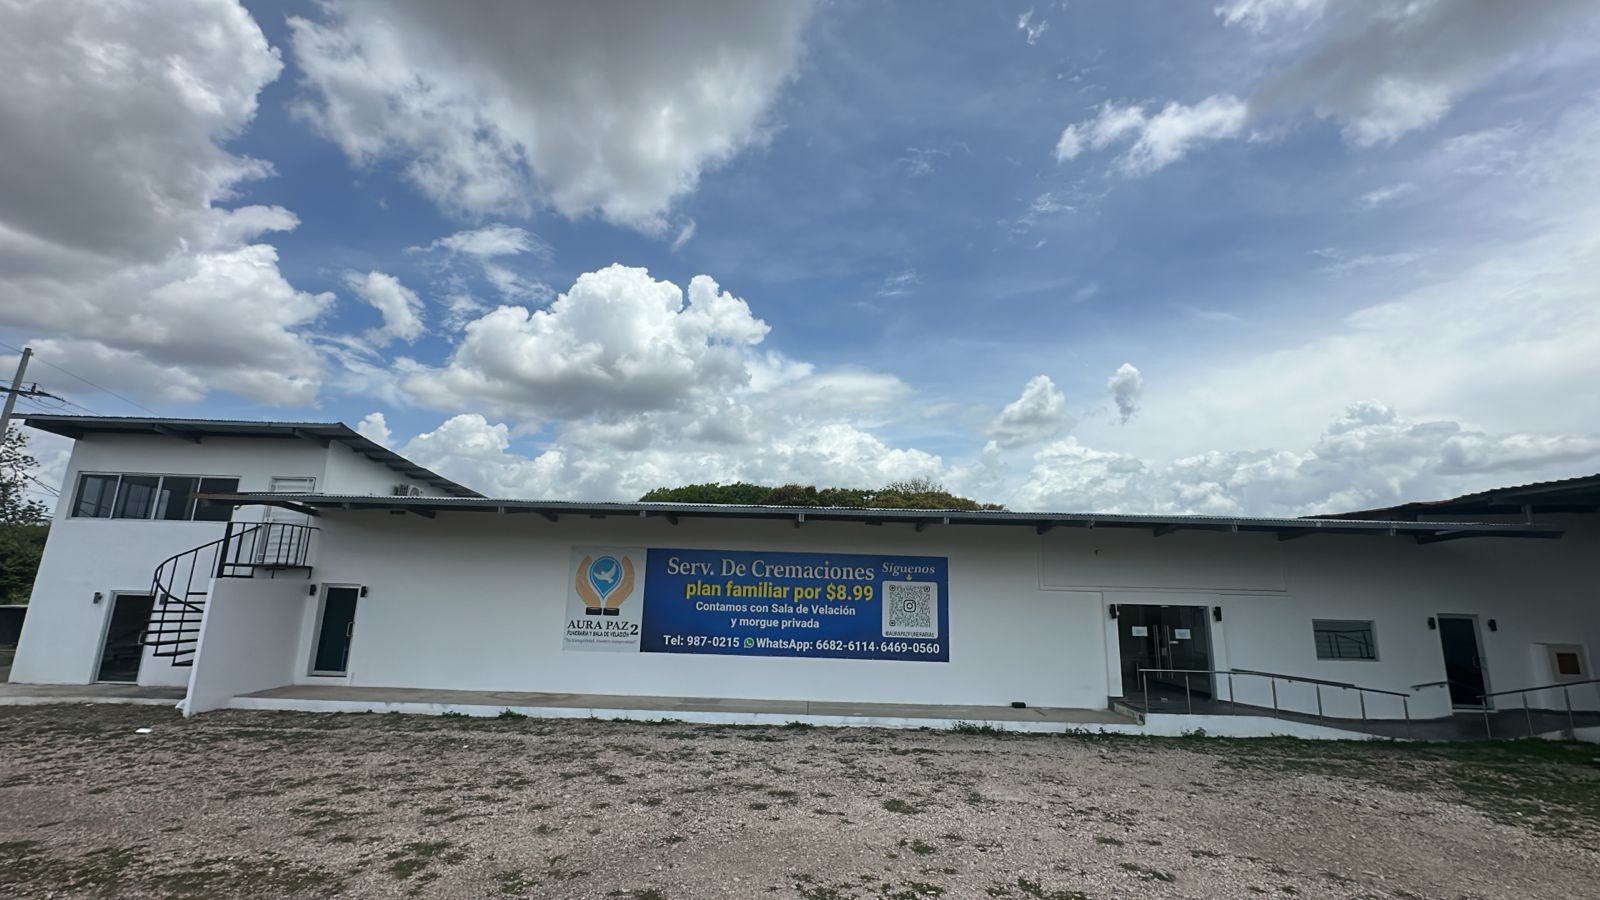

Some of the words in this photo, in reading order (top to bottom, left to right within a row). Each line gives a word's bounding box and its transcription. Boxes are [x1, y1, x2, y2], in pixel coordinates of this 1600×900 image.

[667, 557, 714, 575] Serv.
[720, 558, 747, 577] De
[751, 559, 875, 581] Cremaciones
[881, 561, 936, 577] Síguenos
[686, 580, 721, 600] plan
[725, 581, 789, 598] familiar
[794, 586, 821, 602] por
[826, 582, 874, 602] $8.99
[696, 601, 748, 612] Contamos
[750, 604, 769, 613] con
[771, 603, 793, 613] Sala
[796, 604, 809, 614] de
[811, 604, 856, 616] Velación
[567, 620, 602, 630] AURA
[606, 620, 629, 631] PAZ
[630, 624, 639, 636] 2
[730, 618, 737, 628] y
[739, 618, 779, 629] morgue
[781, 618, 820, 630] privada
[663, 635, 684, 646] Tel:
[687, 636, 740, 648] 987-0215
[756, 637, 813, 652] WhatsApp:
